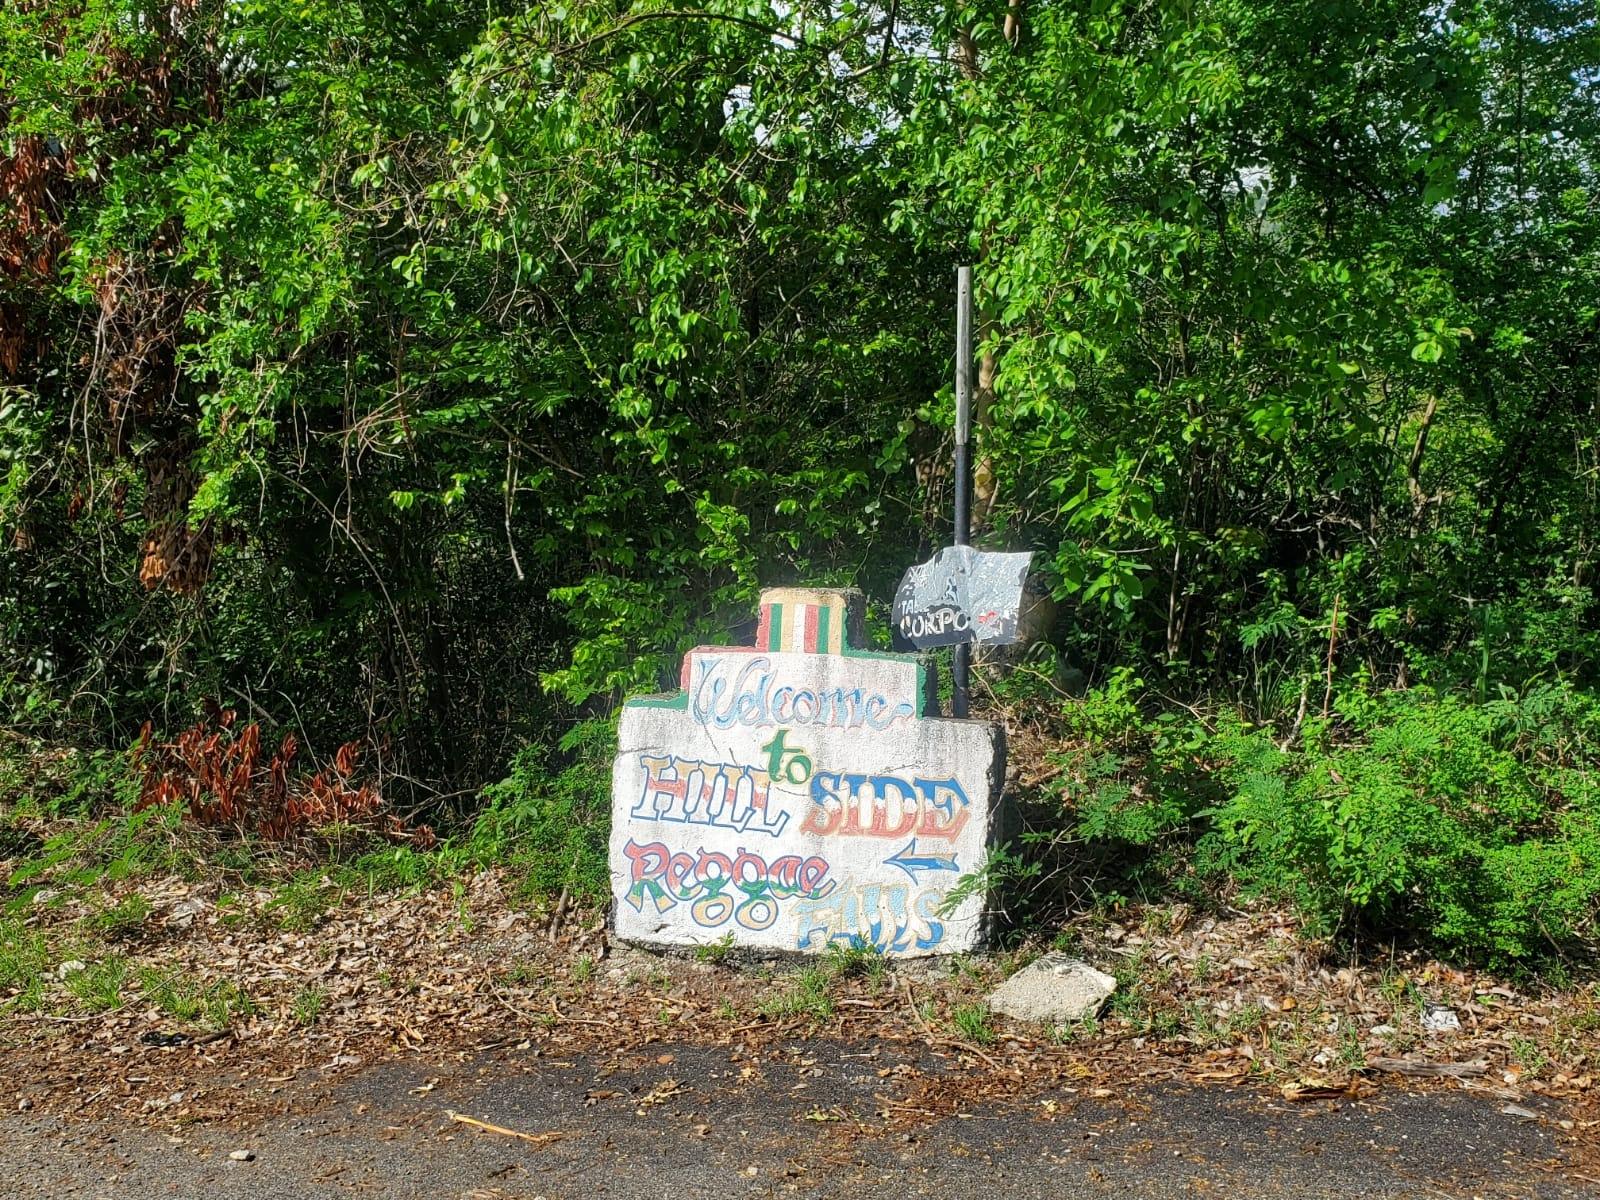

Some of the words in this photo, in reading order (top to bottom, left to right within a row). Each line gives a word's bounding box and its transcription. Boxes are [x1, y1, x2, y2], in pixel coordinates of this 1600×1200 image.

[693, 657, 916, 731] Welcome
[762, 729, 812, 785] to
[630, 754, 791, 838] HILL
[800, 770, 972, 843] SIDE
[623, 838, 837, 931] Reggae
